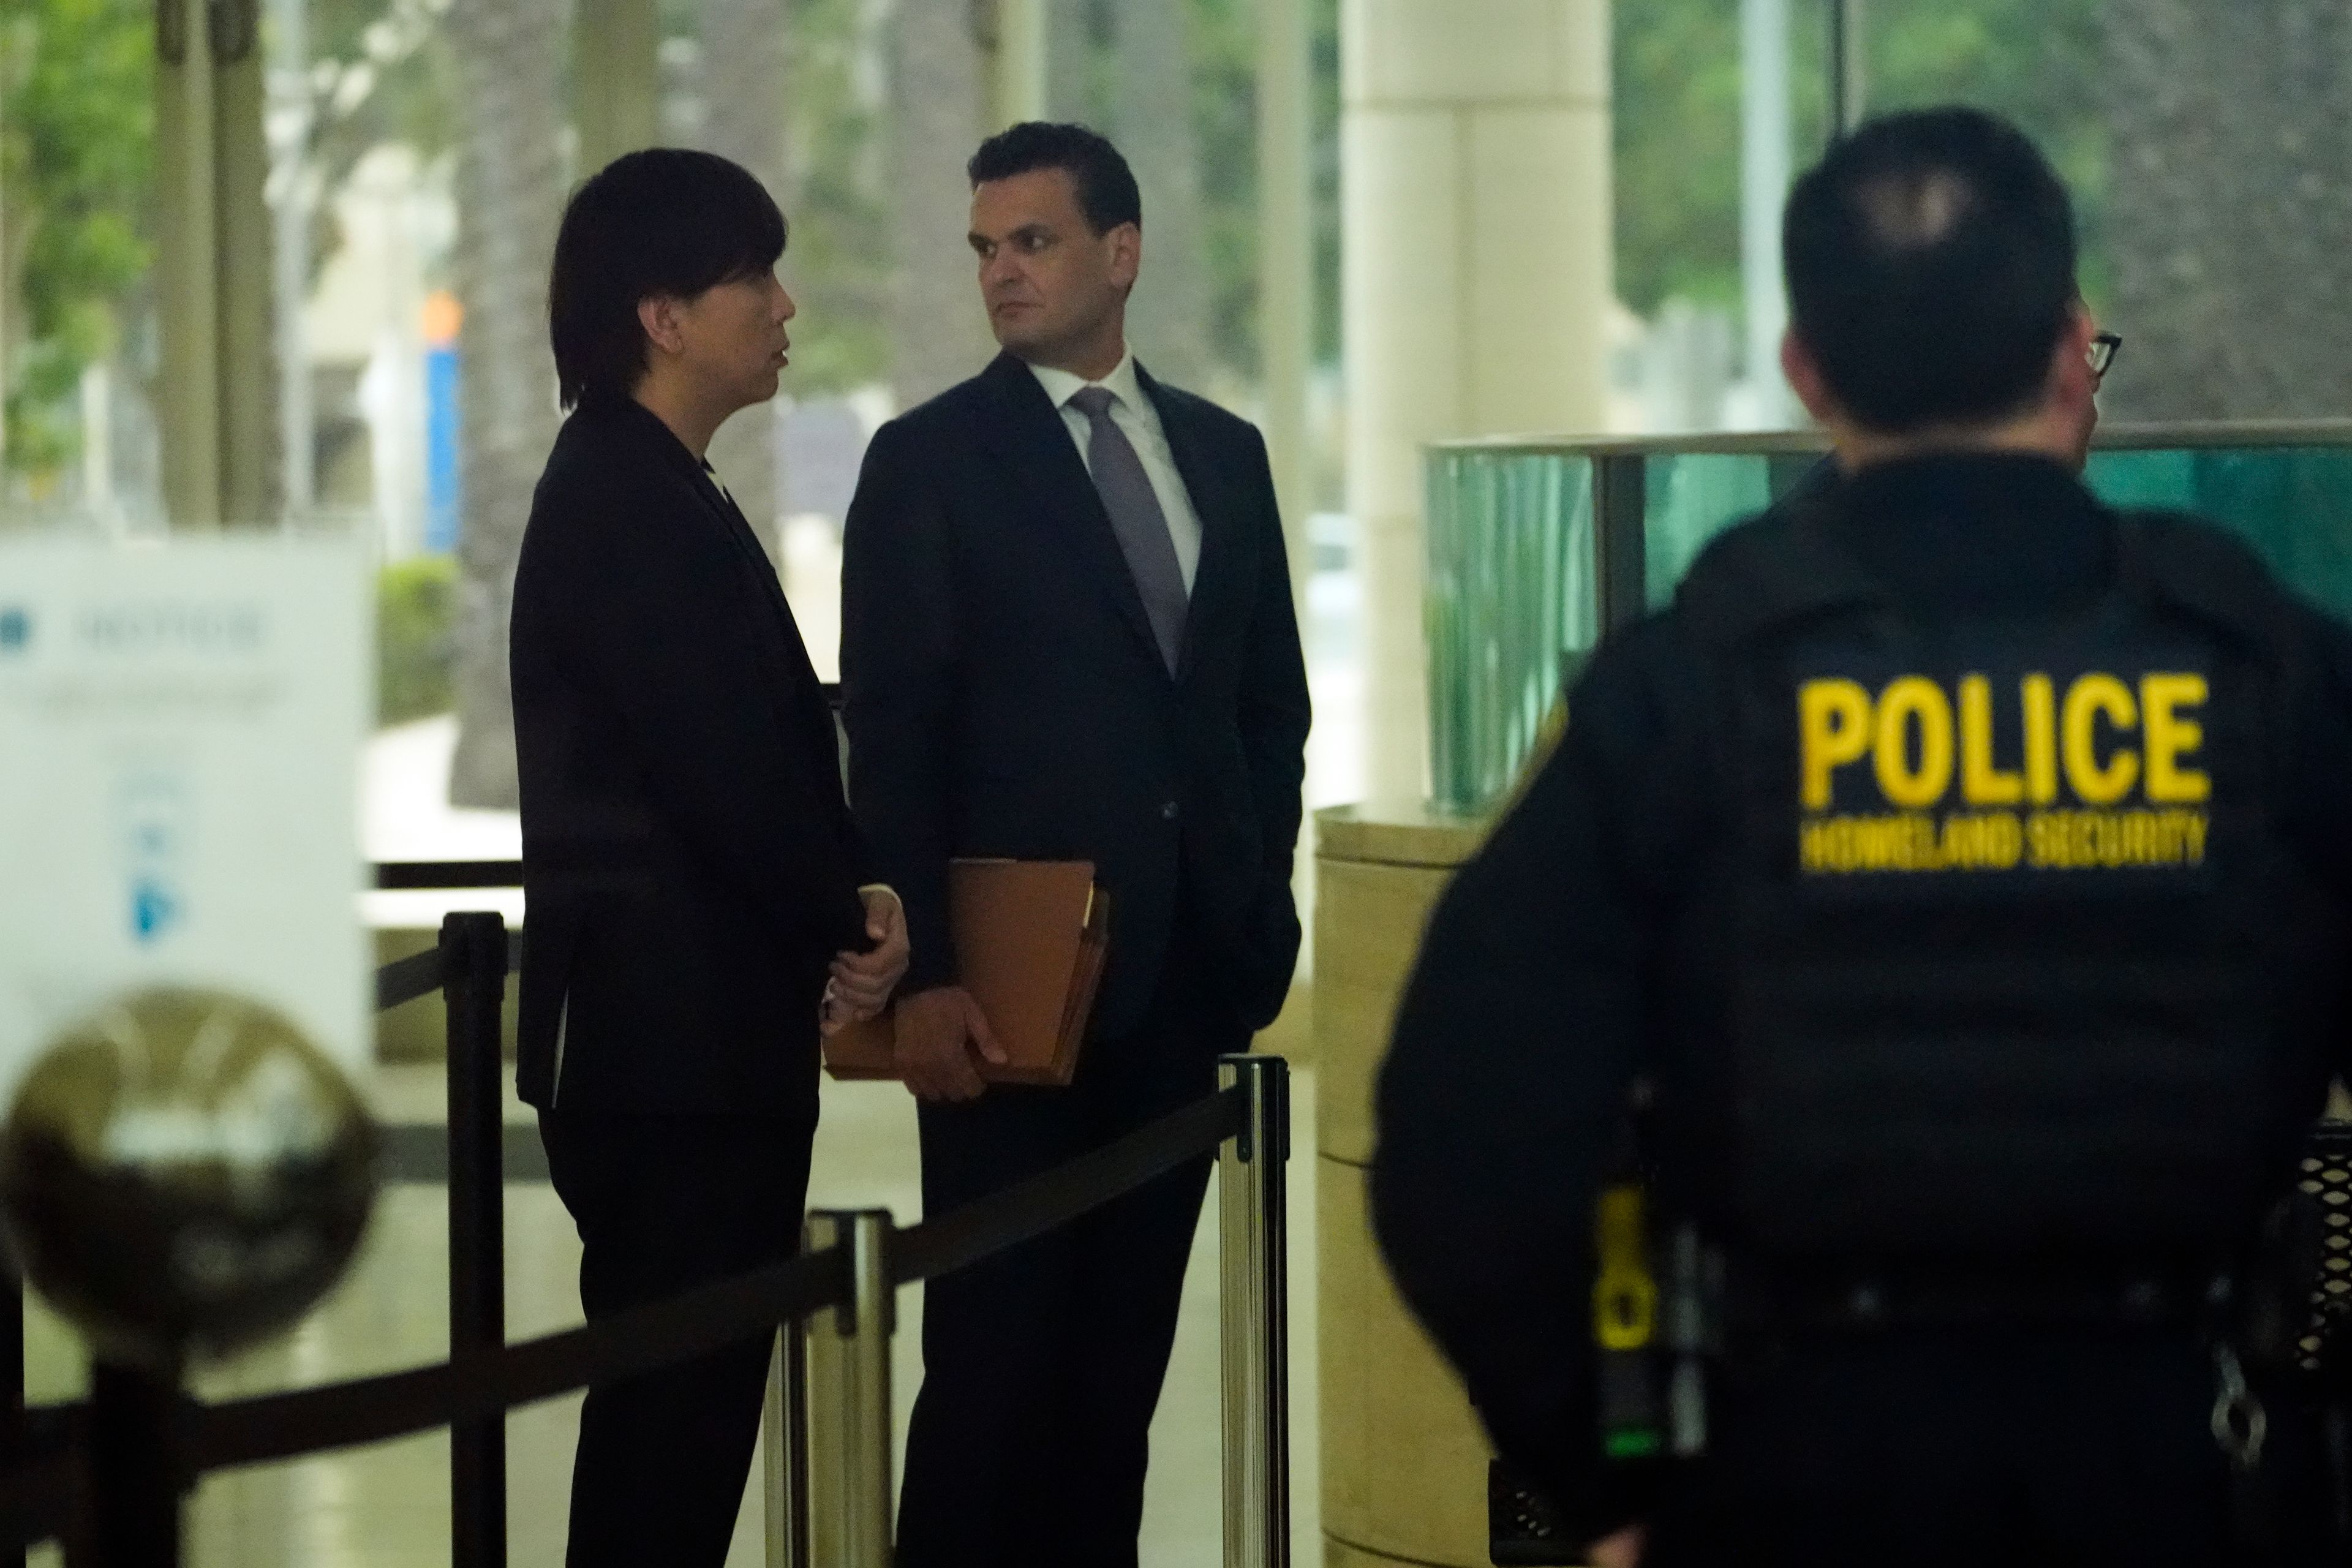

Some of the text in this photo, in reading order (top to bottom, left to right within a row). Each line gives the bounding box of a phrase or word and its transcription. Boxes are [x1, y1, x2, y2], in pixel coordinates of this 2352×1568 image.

[1800, 674, 2210, 809] POLICE
[1801, 810, 2206, 869] HOMELAND SECURITY
